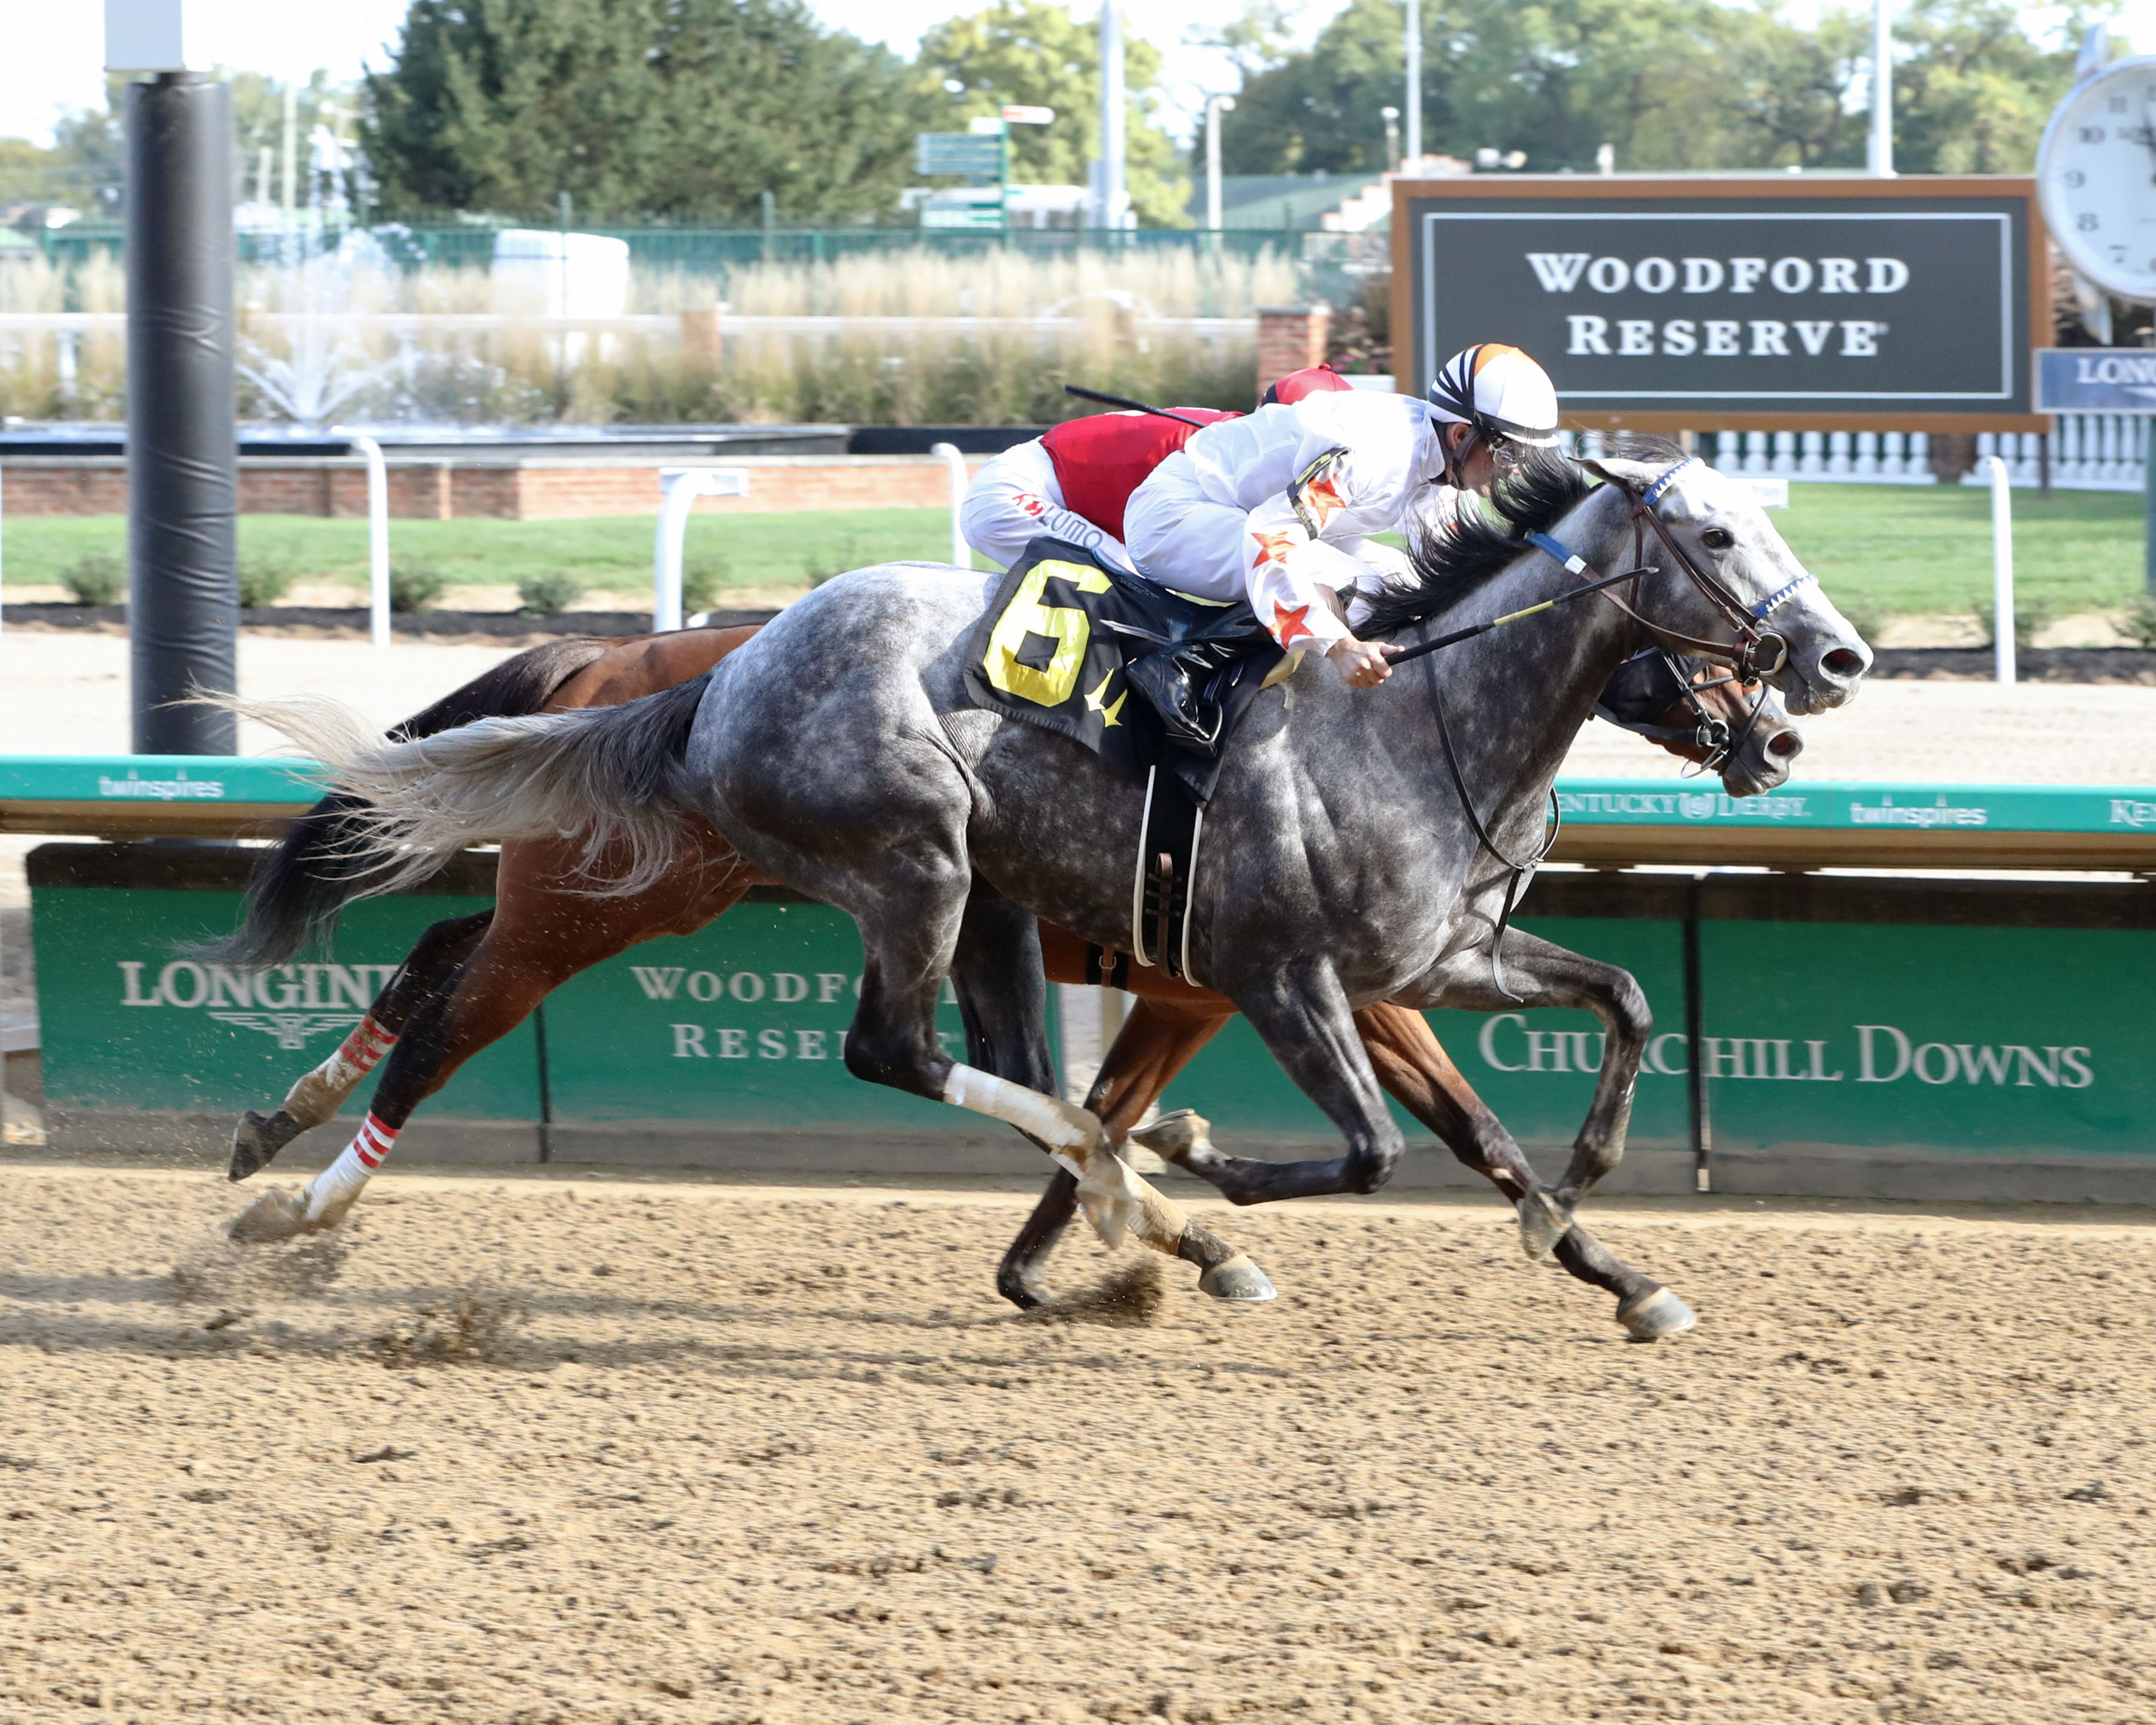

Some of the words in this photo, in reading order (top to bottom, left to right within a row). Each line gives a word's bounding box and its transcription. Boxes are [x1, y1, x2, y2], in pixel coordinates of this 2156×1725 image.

[2065, 170, 2086, 189] 9
[2078, 213, 2099, 231] 8
[2107, 244, 2127, 264] 7
[1527, 253, 1910, 295] WOODFORD
[2076, 357, 2156, 384] LON
[983, 559, 1115, 707] 6
[99, 767, 224, 801] twinspires
[1548, 794, 1677, 816] ENTUCKY
[1849, 792, 1988, 828] twinspires
[117, 961, 401, 1009] LONGIN
[629, 966, 958, 1004] WOODF
[1478, 1013, 1843, 1081] CHUCHILL
[1852, 1025, 2094, 1088] DOWNS
